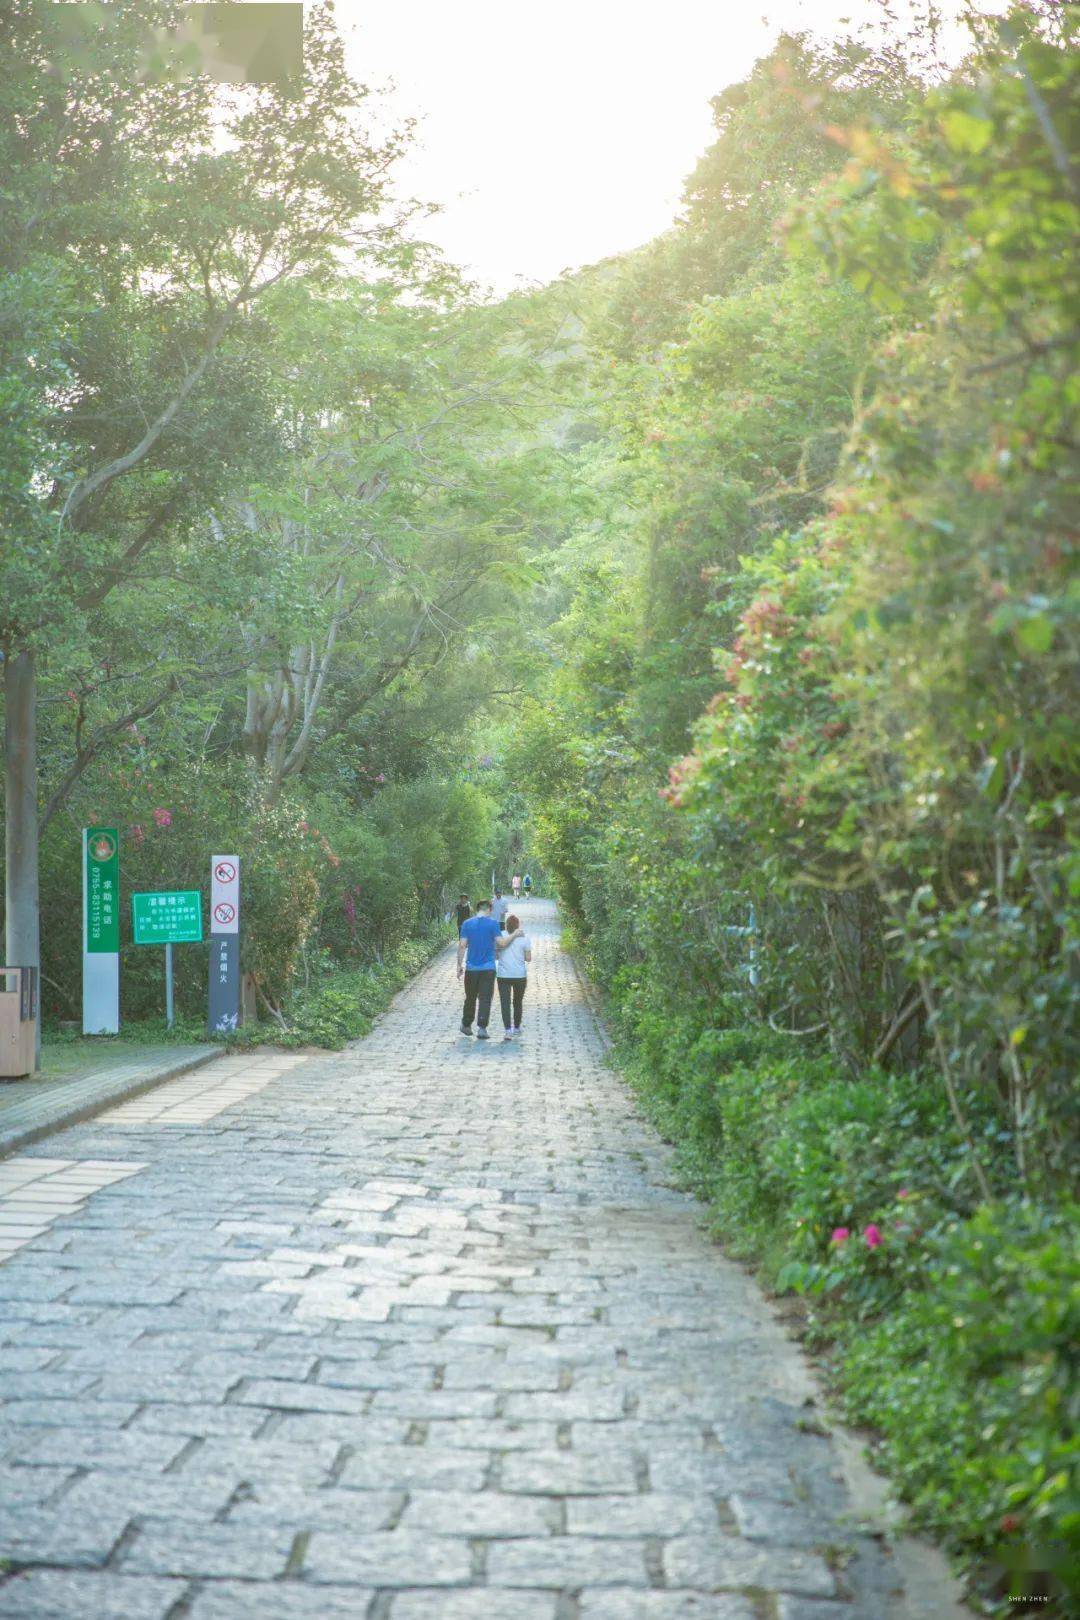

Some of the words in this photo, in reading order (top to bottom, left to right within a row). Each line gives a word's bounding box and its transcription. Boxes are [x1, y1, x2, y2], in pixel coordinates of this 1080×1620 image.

[103, 880, 112, 925] 求助电话
[219, 941, 228, 983] 严禁烟火
